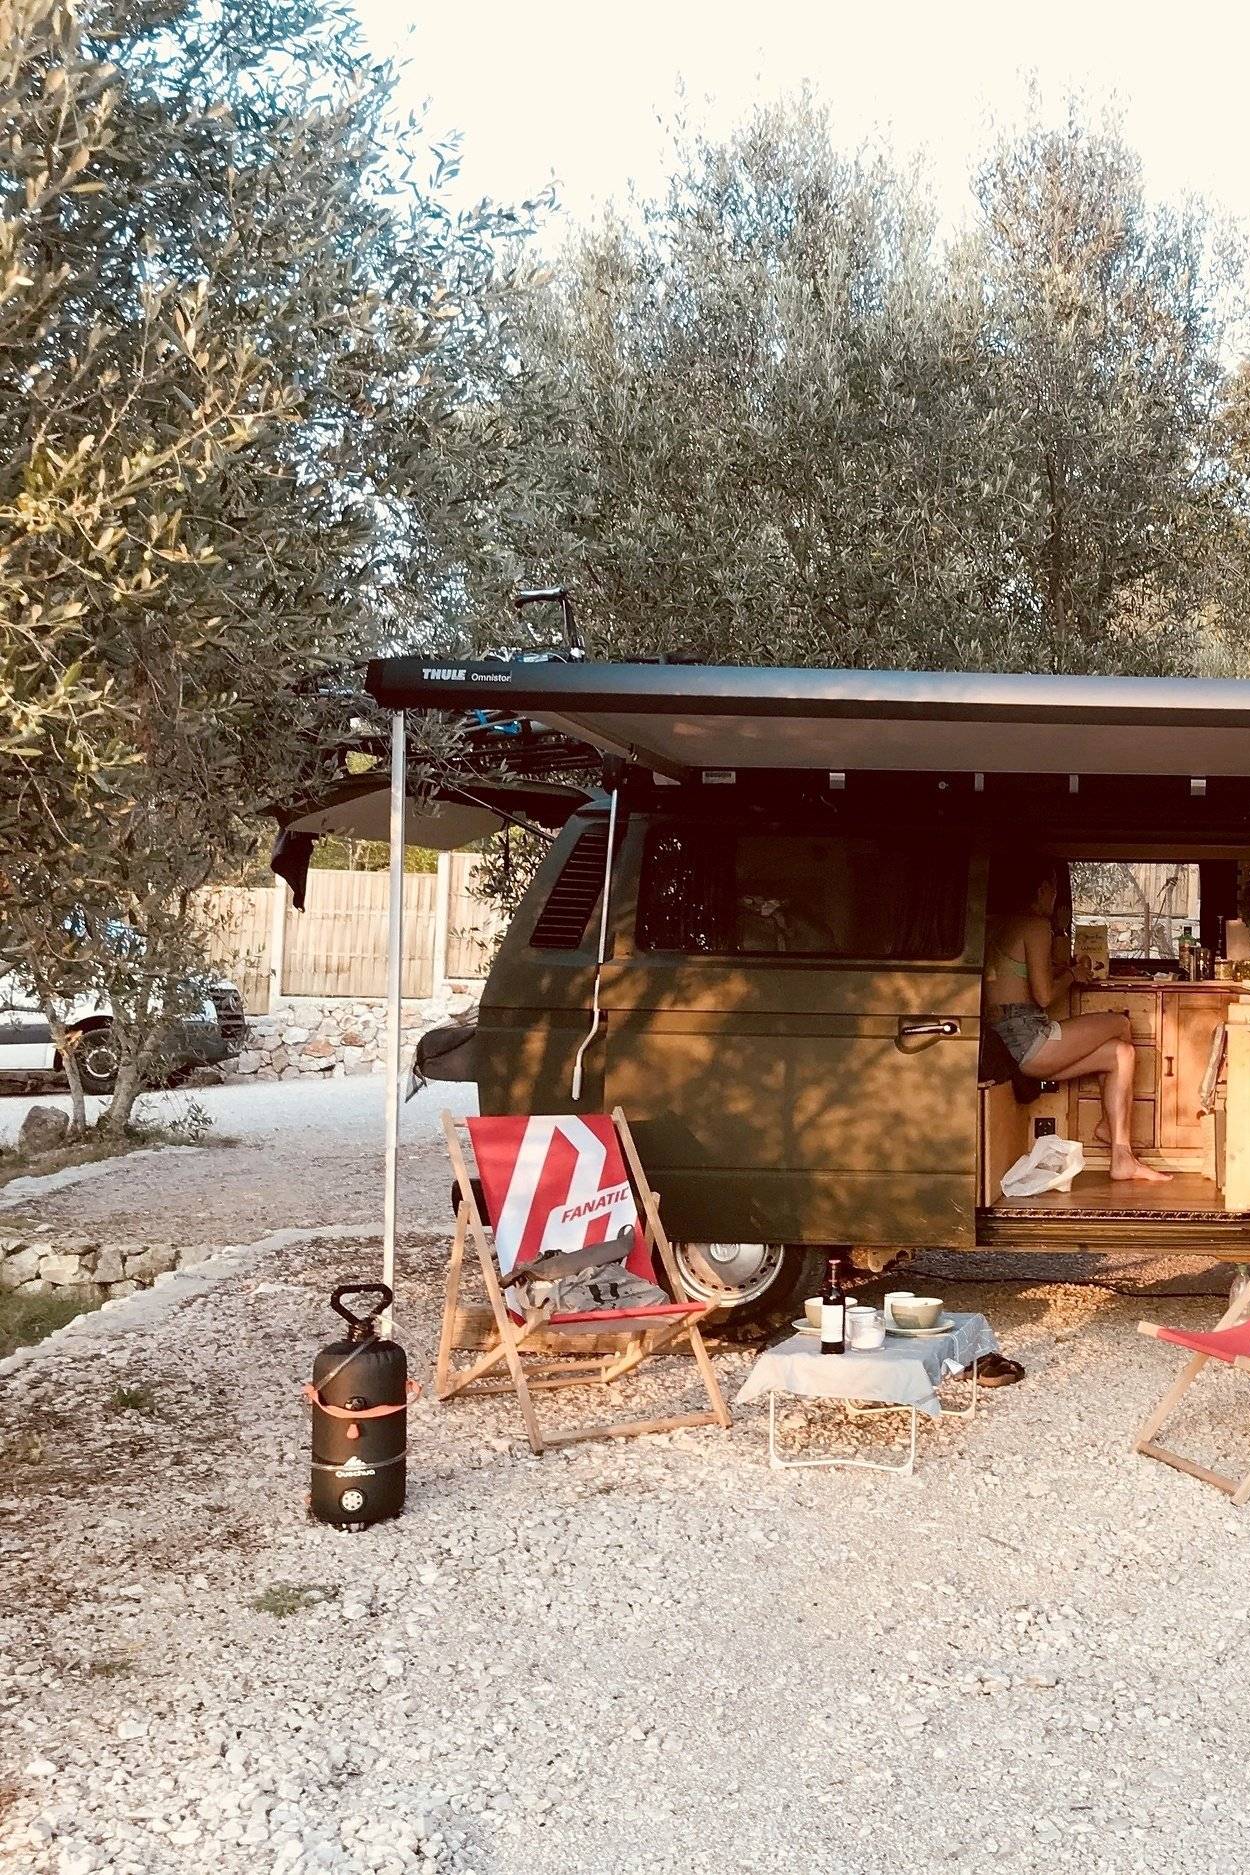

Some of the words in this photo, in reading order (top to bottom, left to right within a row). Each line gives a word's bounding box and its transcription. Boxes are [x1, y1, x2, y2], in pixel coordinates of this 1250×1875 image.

[422, 669, 466, 681] THULE
[471, 673, 511, 683] Omnistor
[561, 1186, 629, 1223] FANATIC
